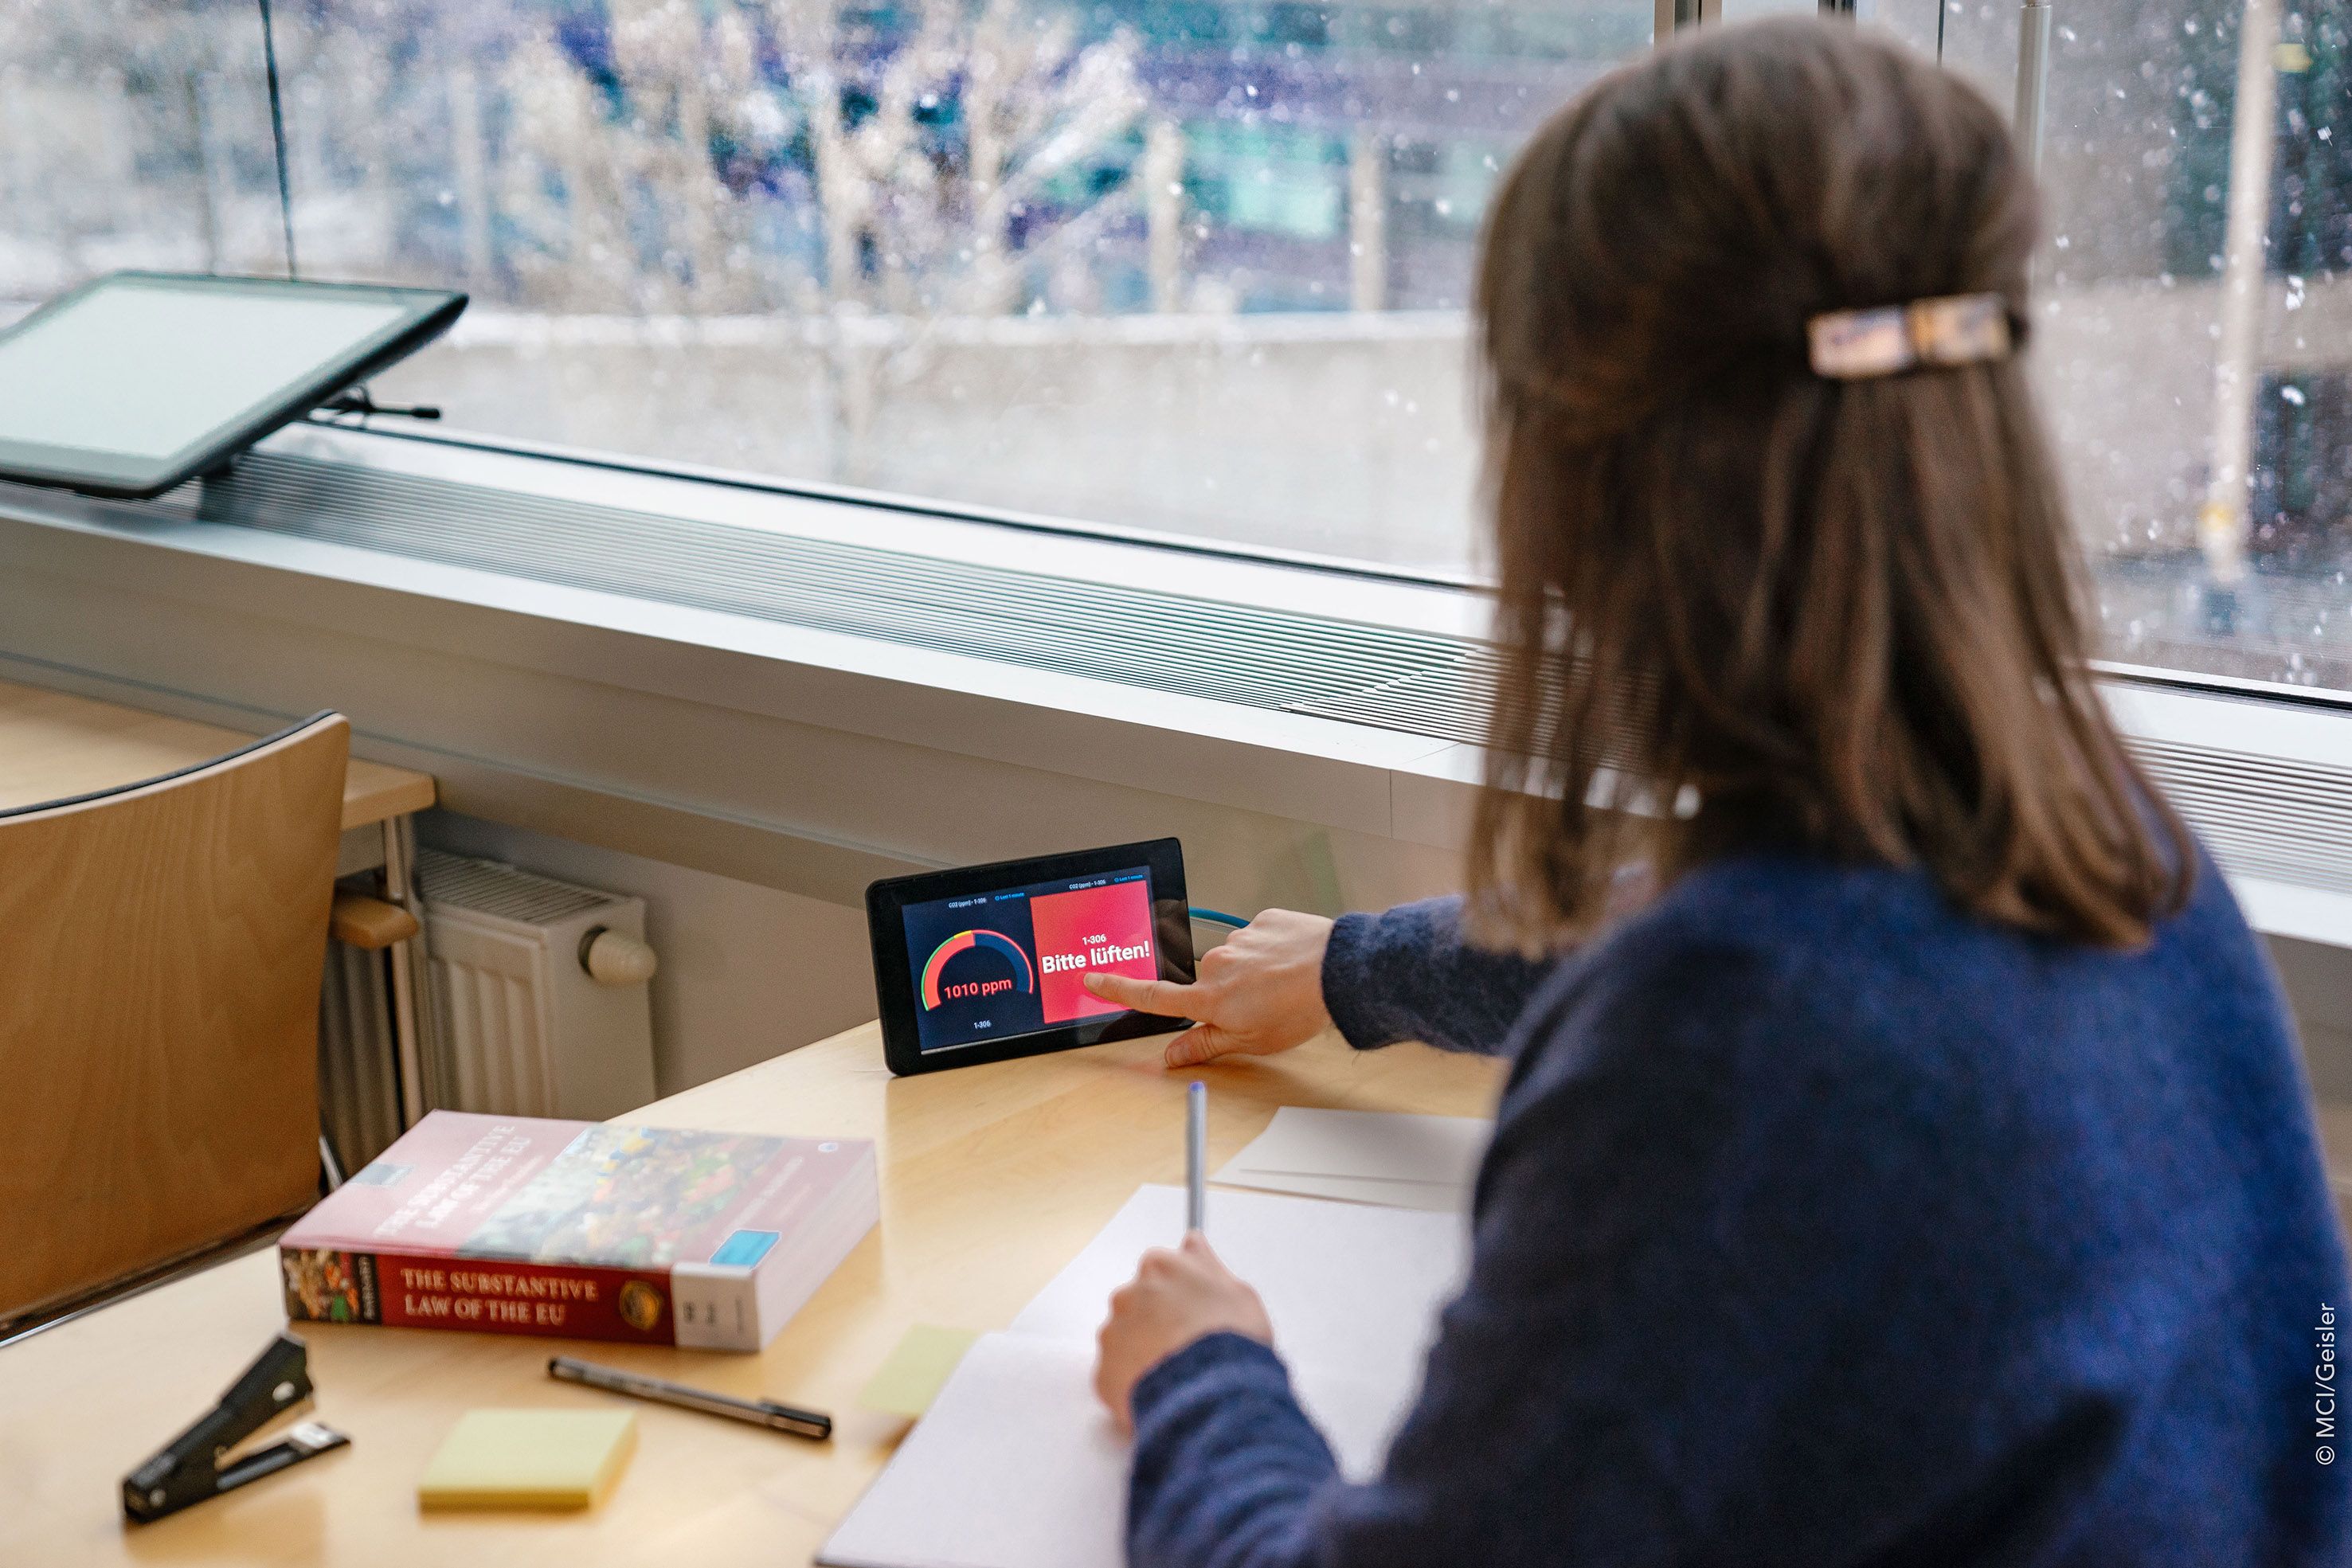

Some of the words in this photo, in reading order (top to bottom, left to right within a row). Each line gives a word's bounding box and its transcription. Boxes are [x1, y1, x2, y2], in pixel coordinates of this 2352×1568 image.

[1082, 933, 1108, 946] 1-306
[1041, 953, 1086, 974] Bitte
[1090, 940, 1150, 966] lüften!
[944, 981, 979, 999] 1010
[981, 979, 1012, 996] ppm
[973, 1020, 992, 1030] 1-306
[401, 1268, 446, 1291] THE
[449, 1271, 599, 1301] SUBSTANTIVE
[405, 1293, 452, 1317] LAW
[454, 1298, 482, 1320] OF
[484, 1299, 532, 1324] THE
[535, 1303, 566, 1326] EU
